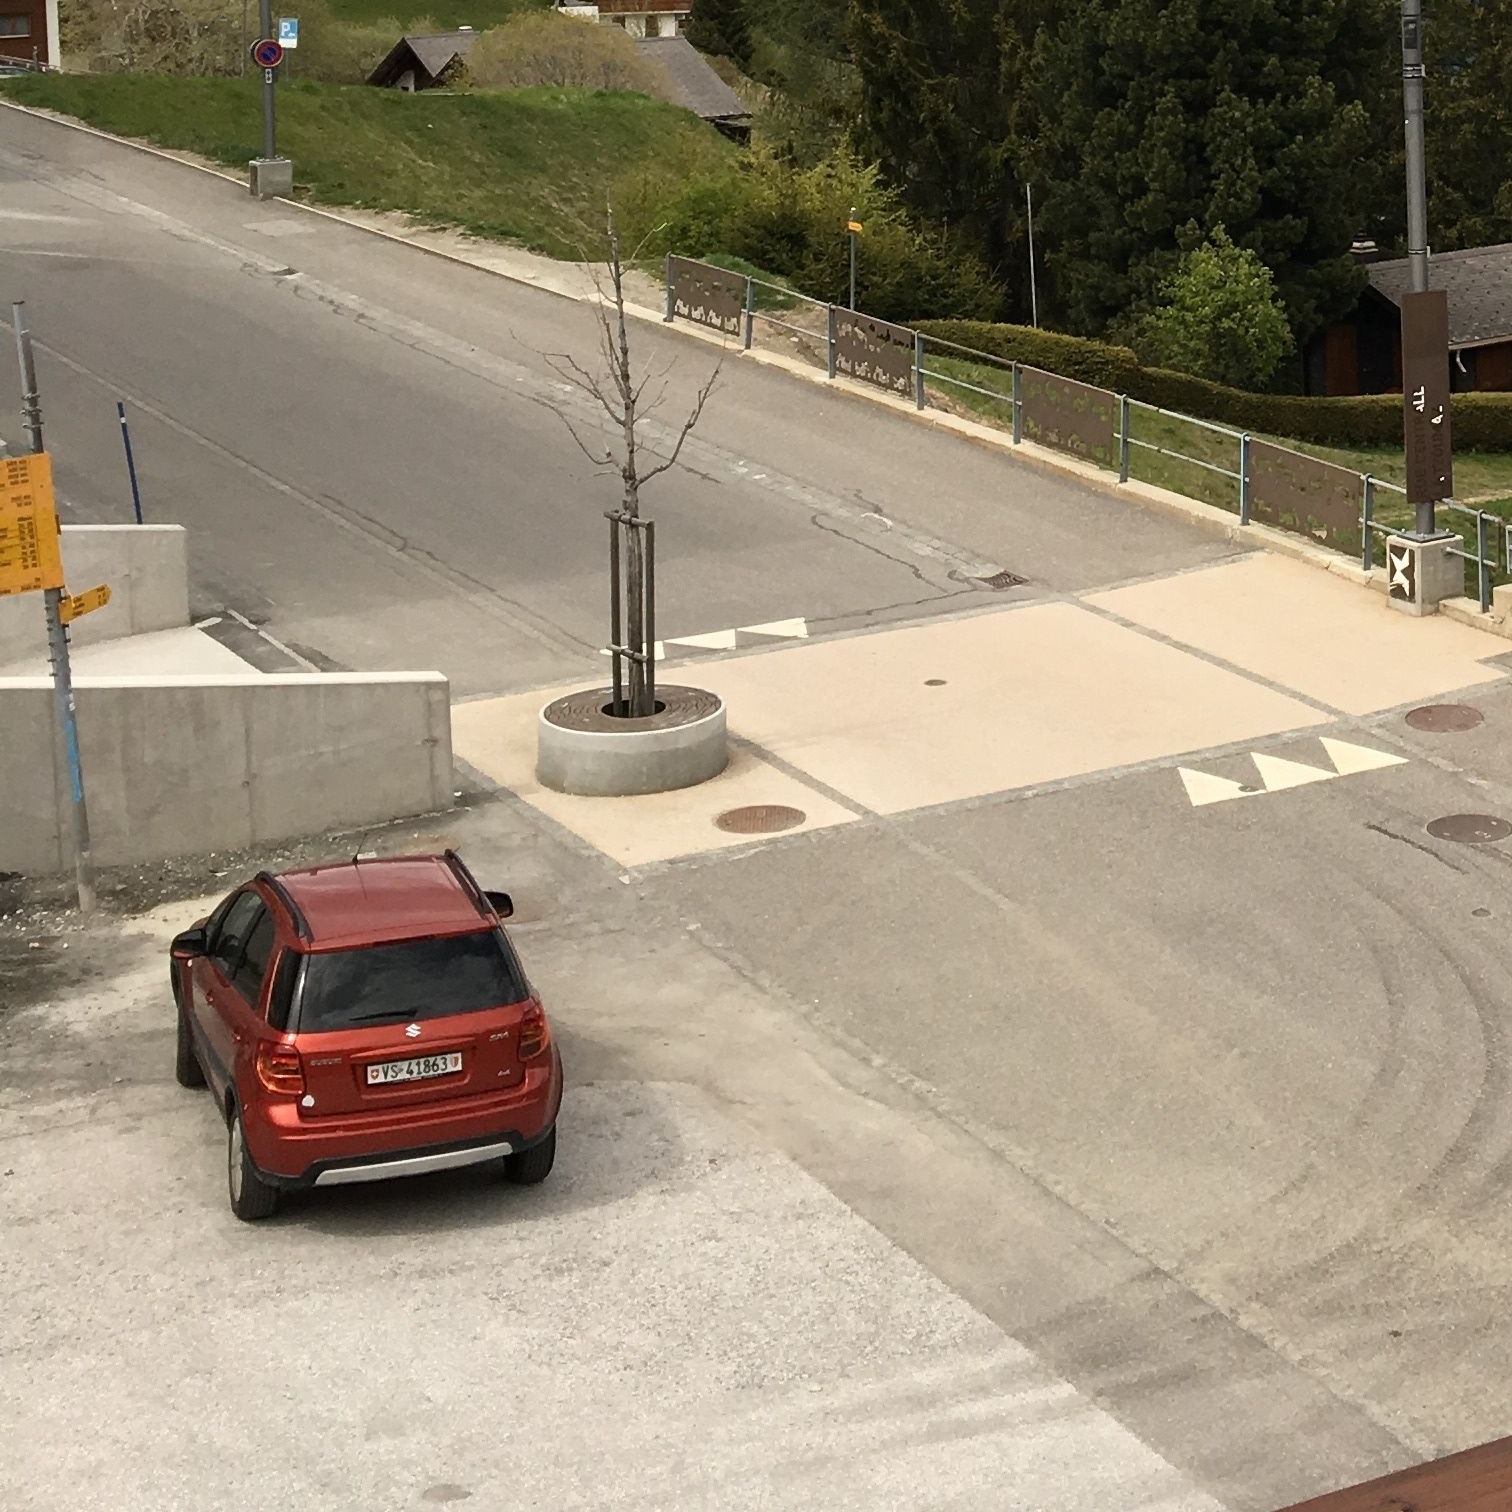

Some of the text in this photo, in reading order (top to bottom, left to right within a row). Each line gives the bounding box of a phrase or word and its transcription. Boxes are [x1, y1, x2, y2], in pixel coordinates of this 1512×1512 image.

[281, 22, 291, 36] P
[381, 1064, 399, 1080] VS
[405, 1056, 448, 1076] 41863
